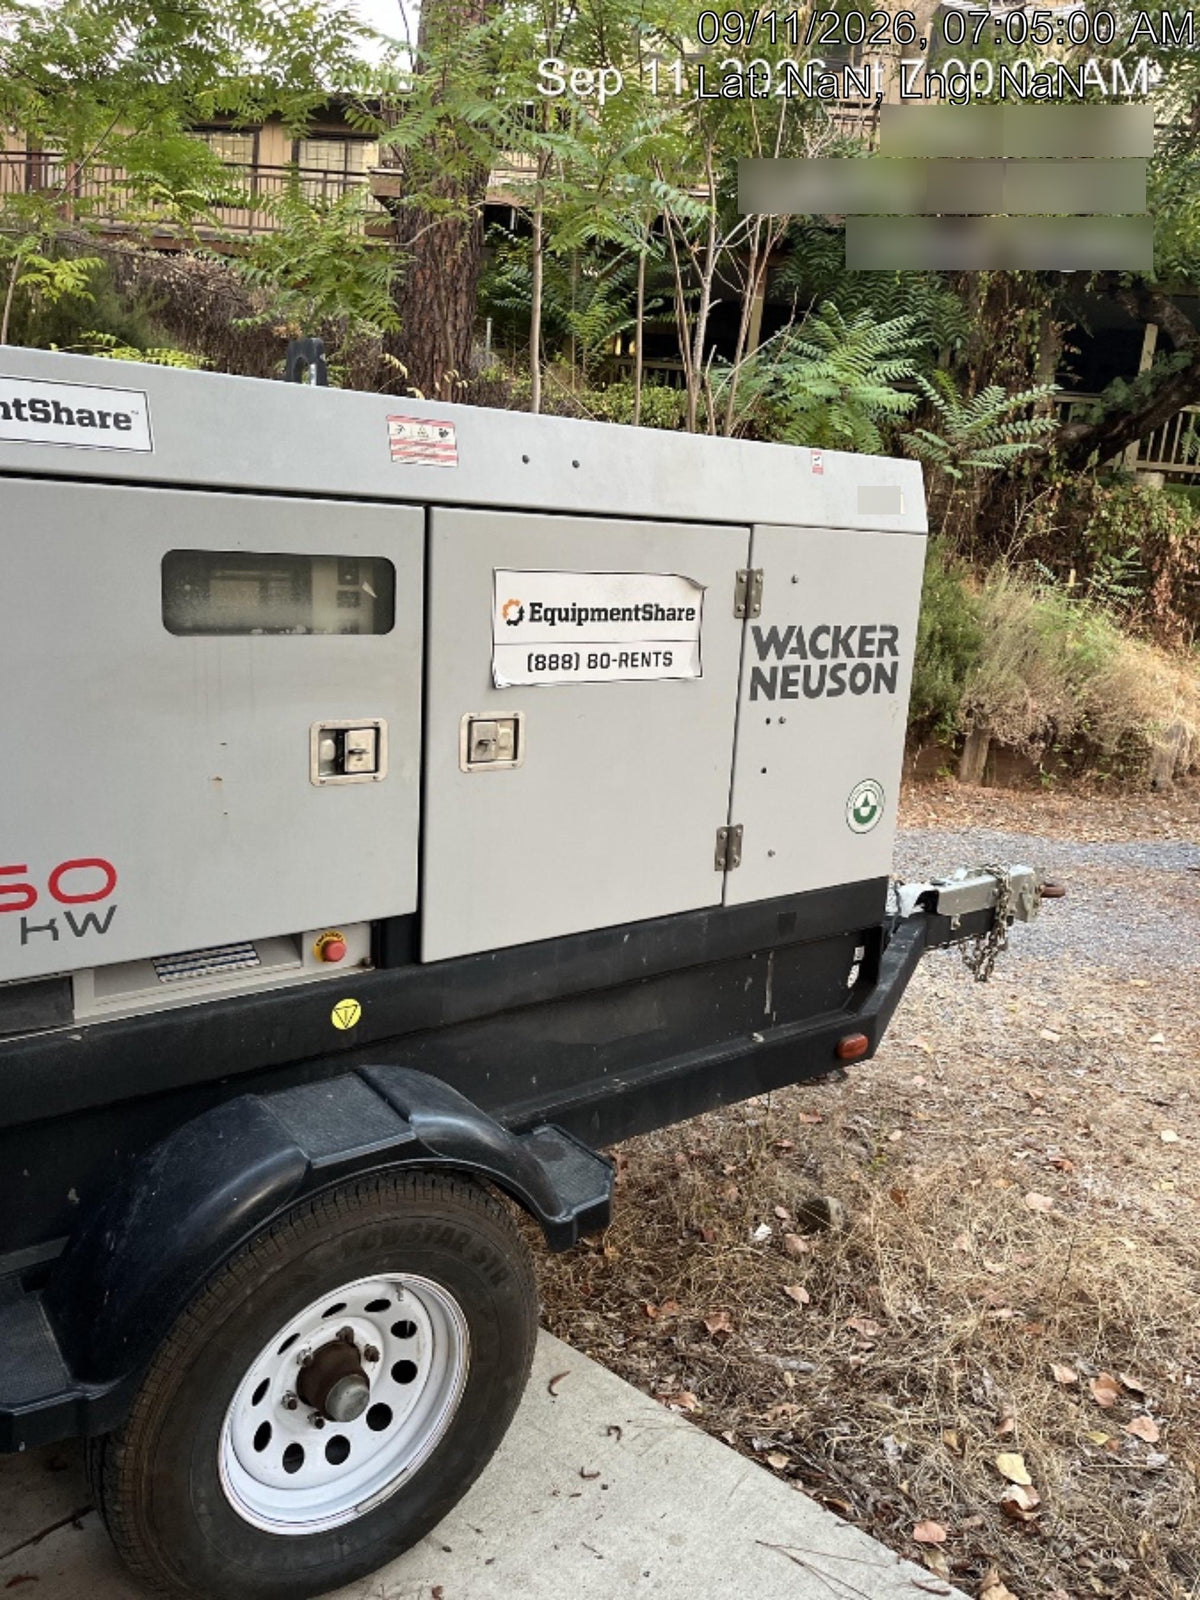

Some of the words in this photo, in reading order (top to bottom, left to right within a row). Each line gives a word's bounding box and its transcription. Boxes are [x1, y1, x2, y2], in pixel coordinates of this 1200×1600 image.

[529, 602, 696, 627] EquipmentShare
[751, 624, 899, 661] WACKER
[527, 651, 580, 673] (888)
[750, 661, 899, 701] NEUSON
